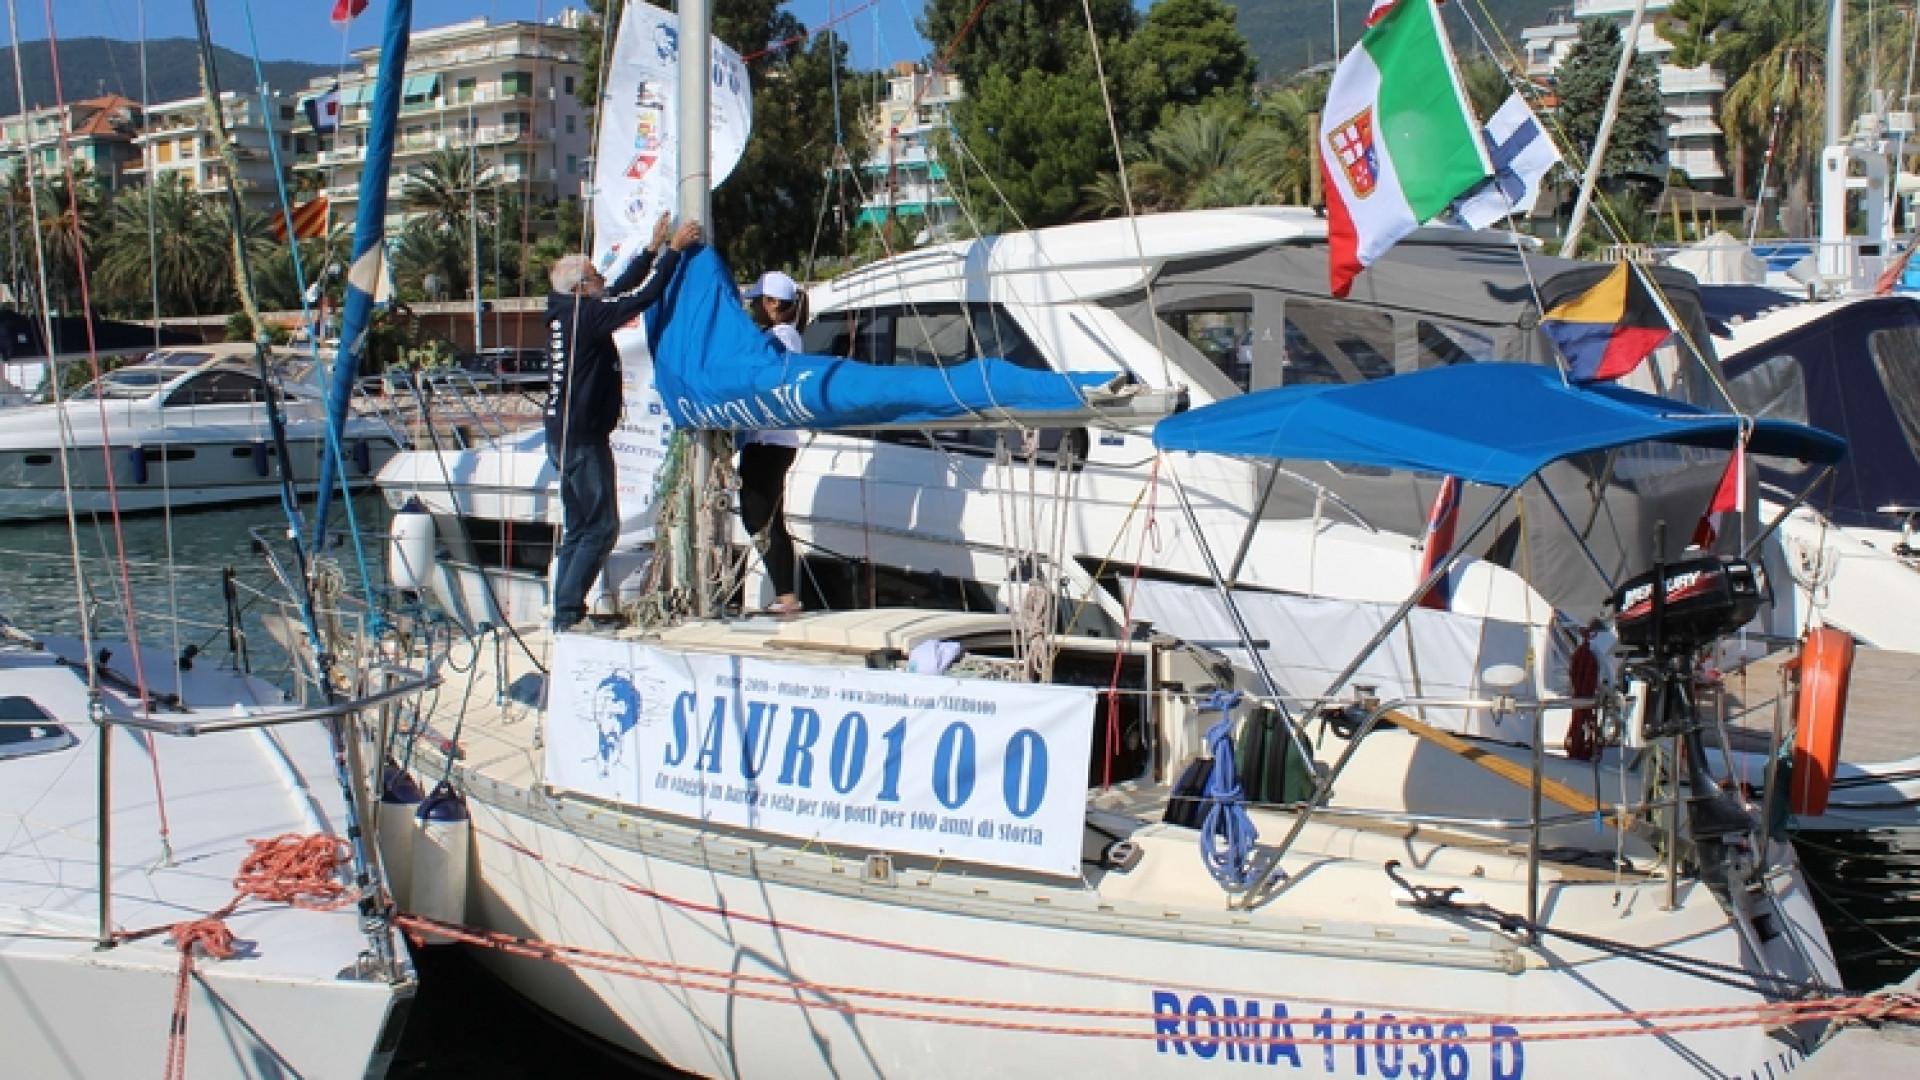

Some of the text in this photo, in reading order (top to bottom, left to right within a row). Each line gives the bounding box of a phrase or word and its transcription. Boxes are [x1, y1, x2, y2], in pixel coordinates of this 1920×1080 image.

[1620, 570, 1701, 612] MERURY
[797, 798, 819, 817] per
[844, 804, 877, 825] porti
[880, 808, 905, 828] per
[910, 810, 938, 832] 100
[939, 814, 974, 837] anni
[977, 818, 995, 839] di
[997, 821, 1043, 846] storia
[1151, 990, 1524, 1080] ROMA 11036 D
